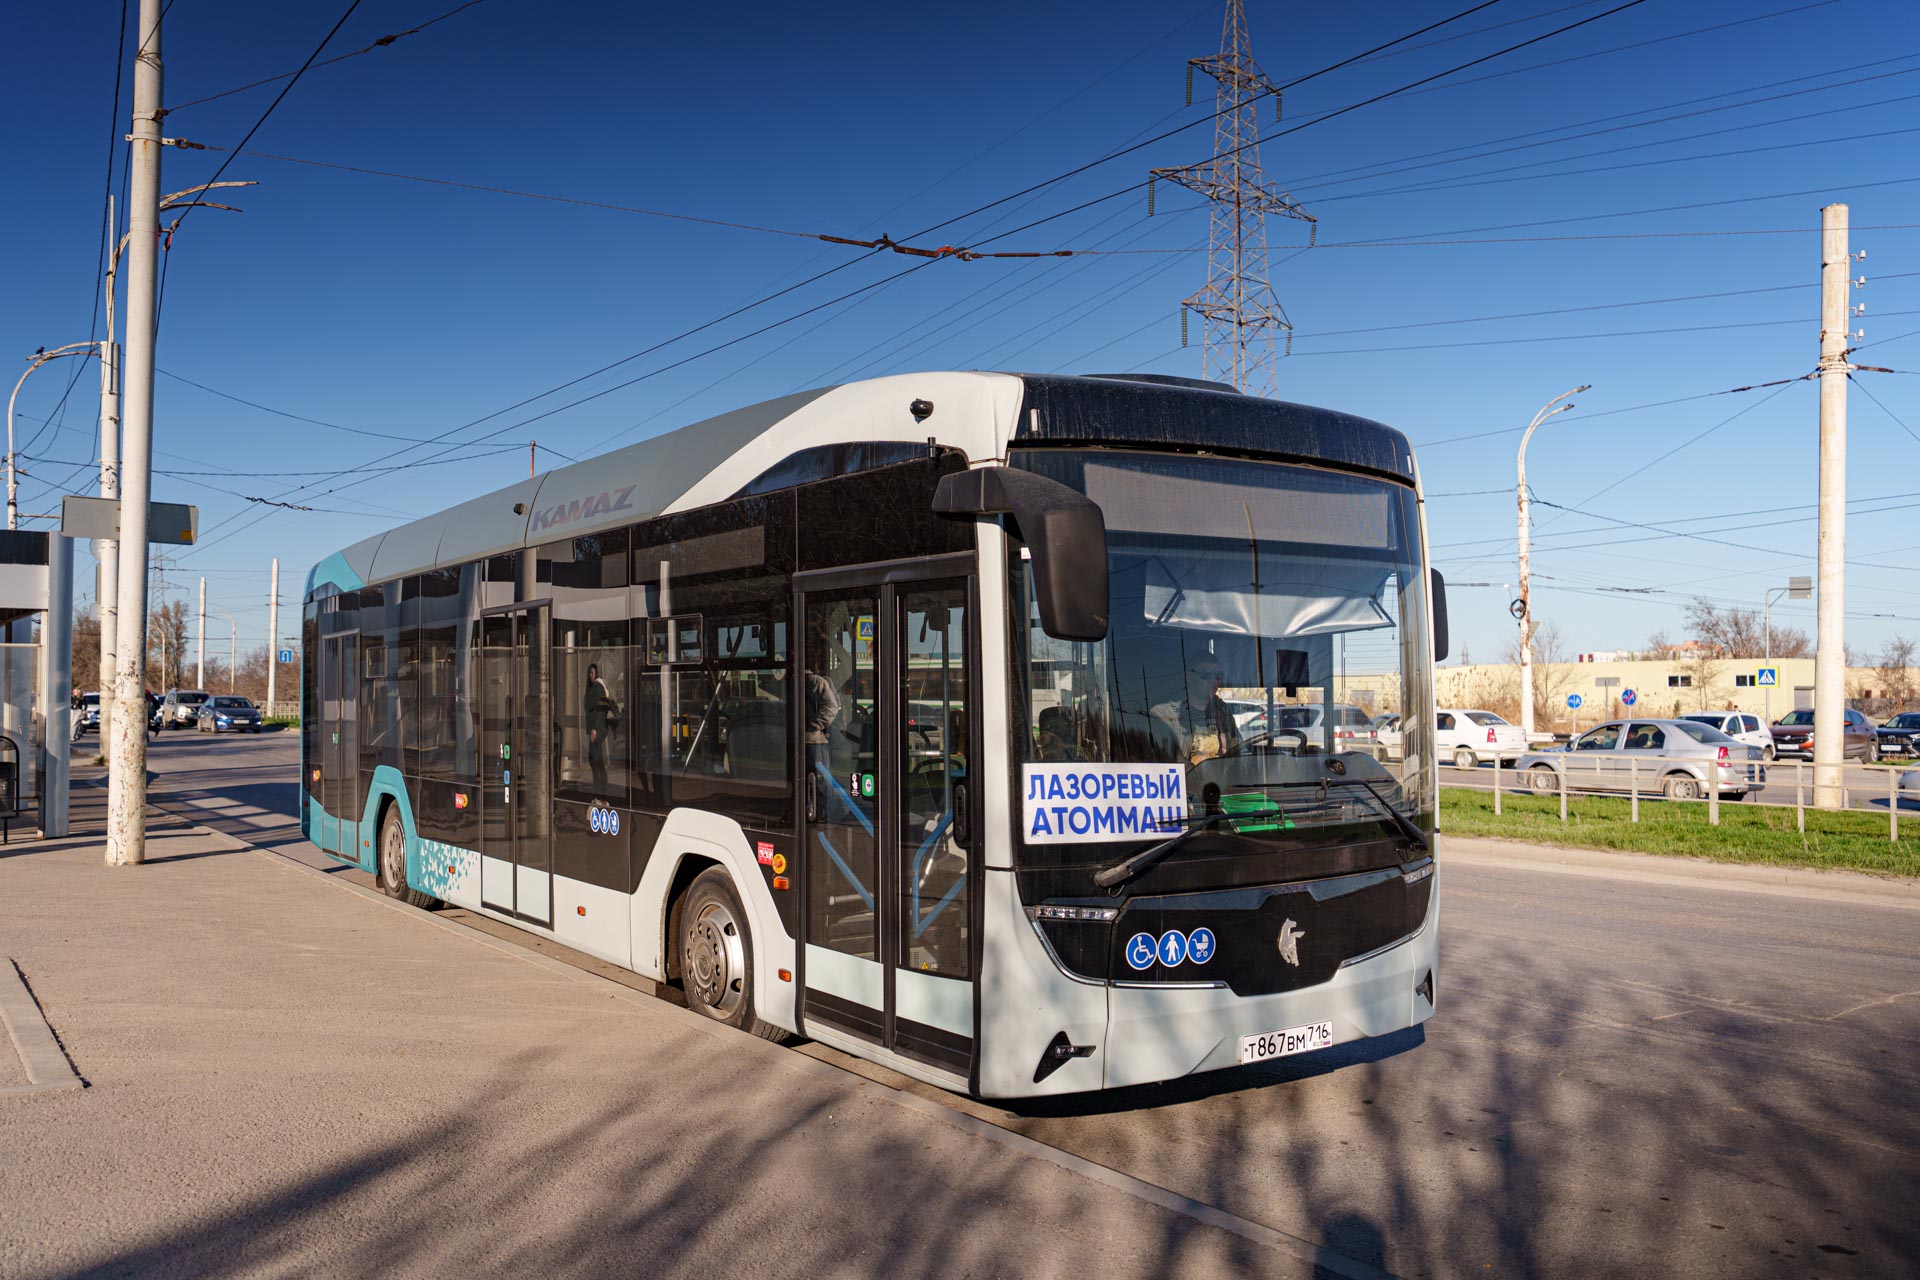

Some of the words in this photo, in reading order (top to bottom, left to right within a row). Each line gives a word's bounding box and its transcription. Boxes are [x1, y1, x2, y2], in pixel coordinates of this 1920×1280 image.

[531, 484, 638, 532] KAMAZ
[1028, 768, 1181, 800] ЛАЗОРЕВЫЙ
[1031, 806, 1183, 836] АТОММАШ
[1308, 1024, 1329, 1042] 716
